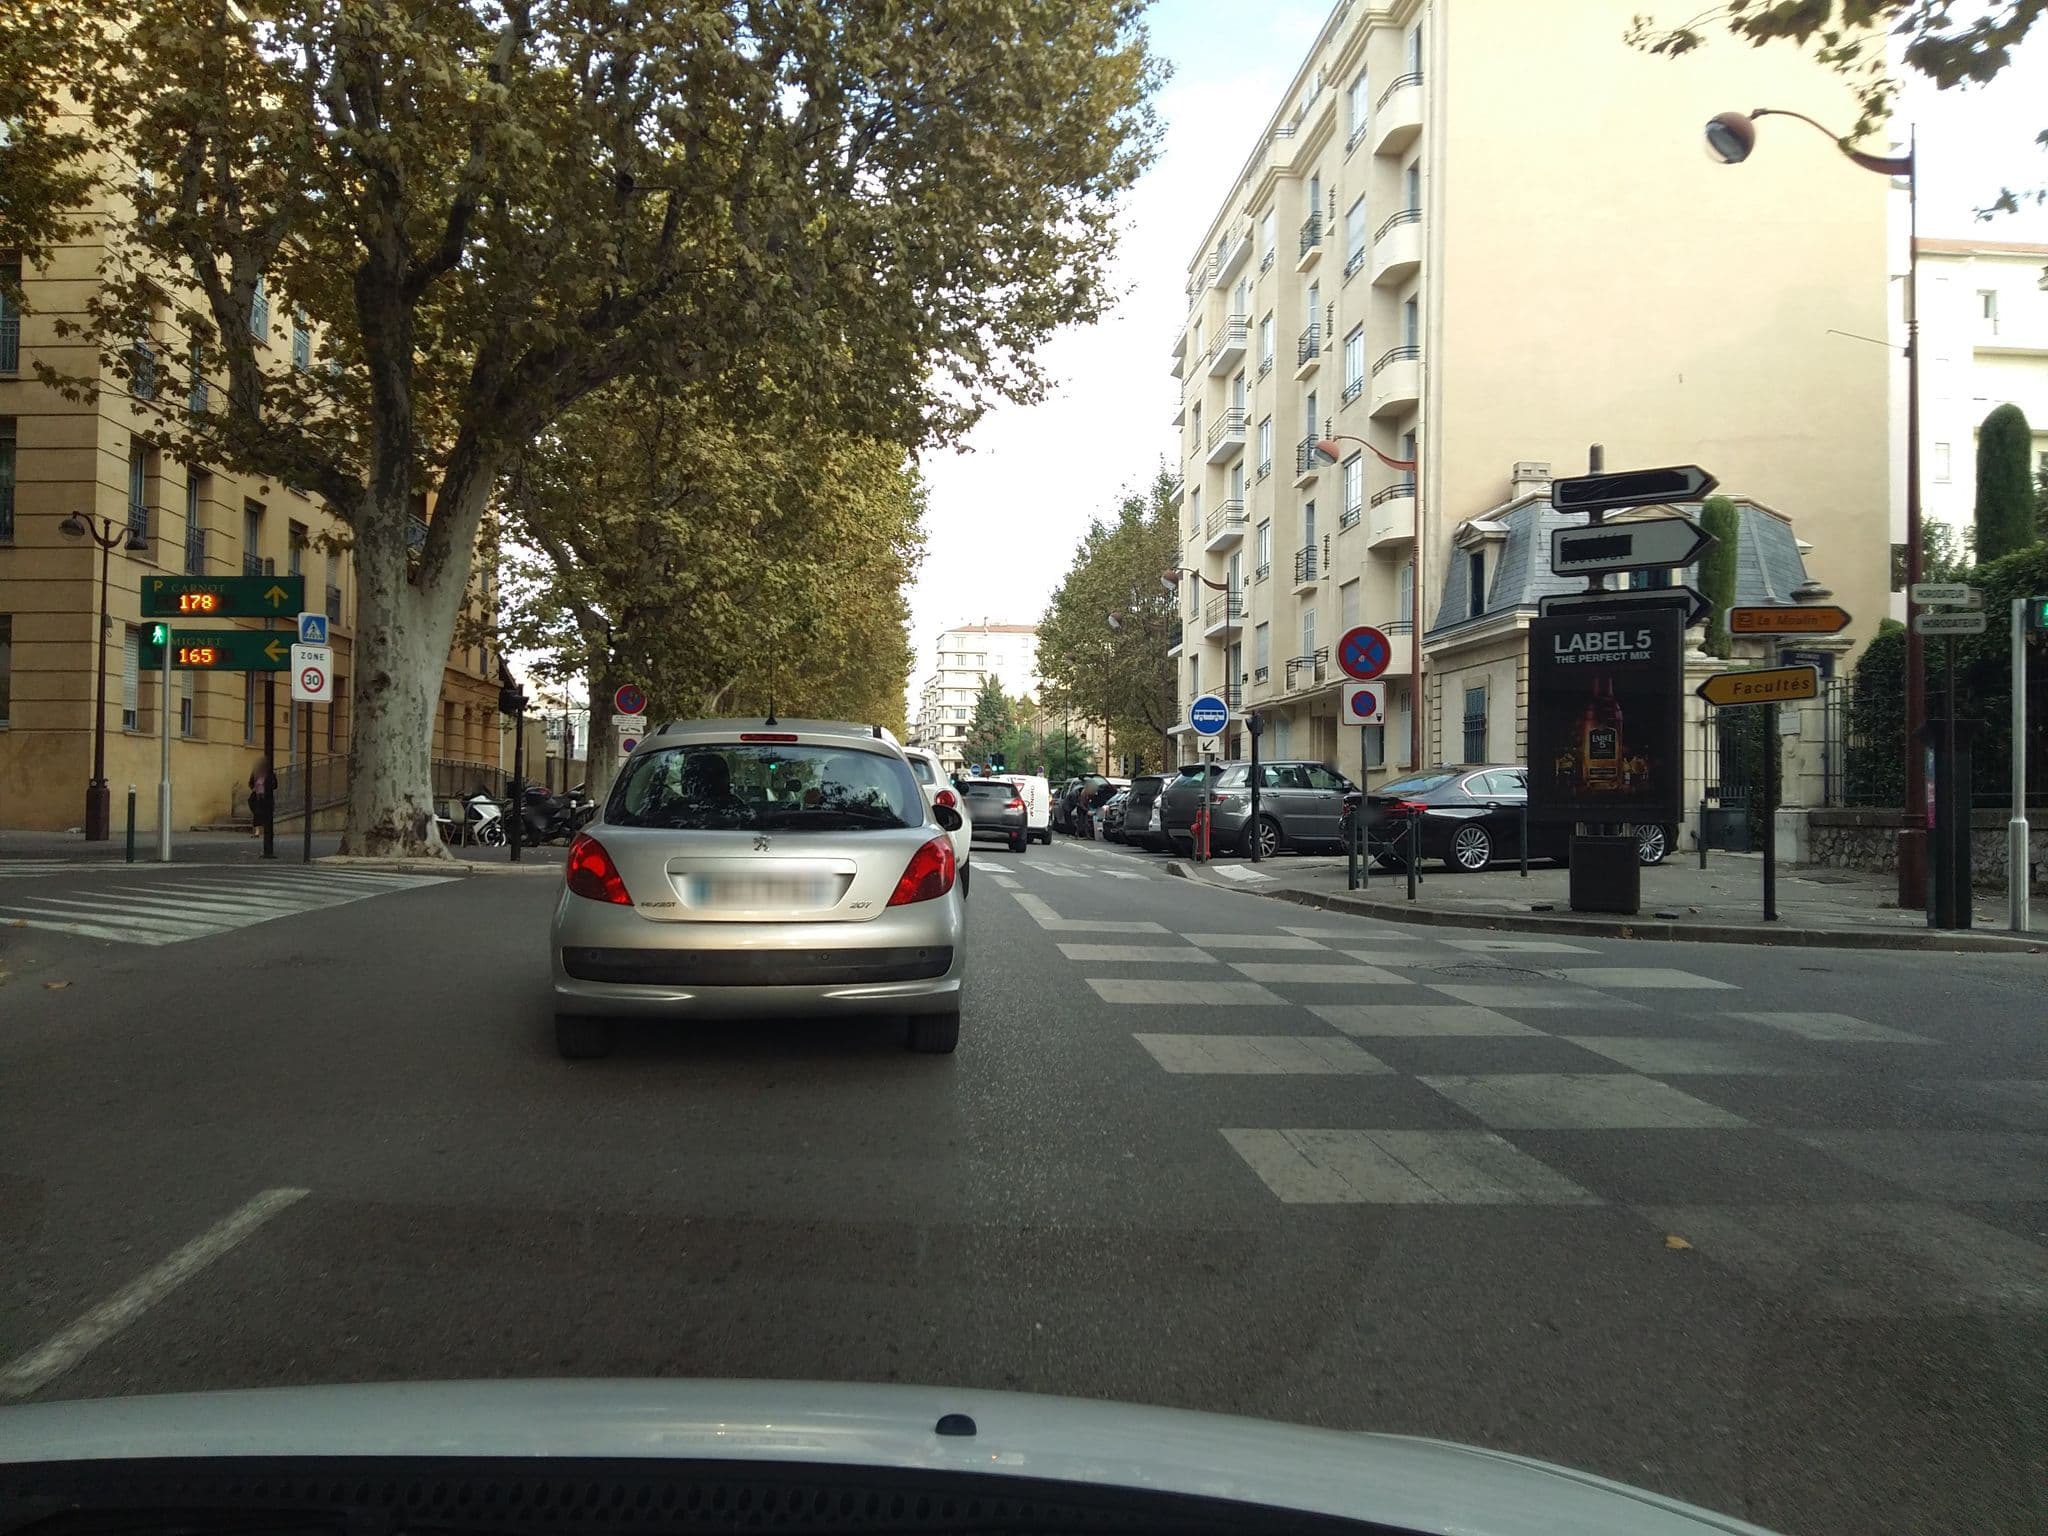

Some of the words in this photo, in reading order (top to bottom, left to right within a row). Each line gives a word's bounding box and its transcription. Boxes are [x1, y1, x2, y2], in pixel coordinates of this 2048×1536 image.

[153, 580, 164, 592] P
[170, 584, 225, 593] CARNOT
[179, 595, 213, 609] 178
[170, 637, 223, 647] MIGNET
[1554, 630, 1634, 654] LABEL
[1636, 629, 1652, 650] 5
[179, 648, 213, 663] 165
[300, 651, 325, 661] ZONE
[1555, 655, 1576, 664] THE
[1579, 653, 1627, 663] PERFECT
[1630, 651, 1651, 660] MIX
[305, 674, 320, 686] 30
[1733, 676, 1810, 695] Facultés
[850, 901, 872, 909] 207
